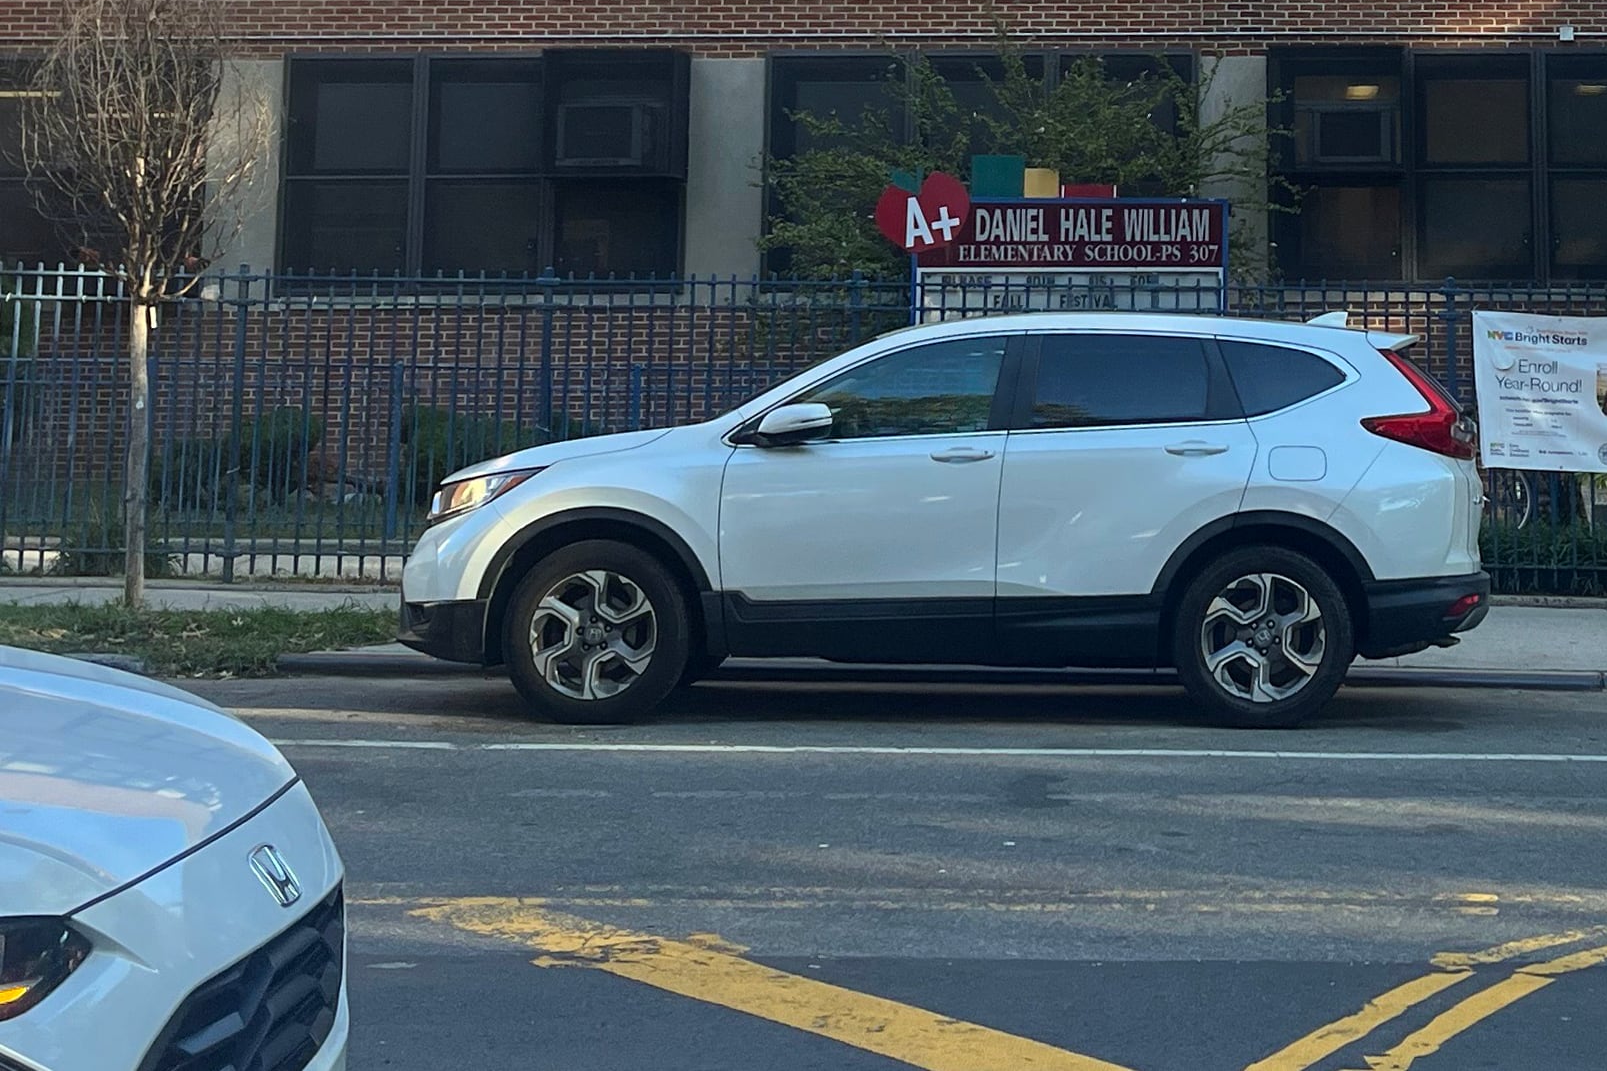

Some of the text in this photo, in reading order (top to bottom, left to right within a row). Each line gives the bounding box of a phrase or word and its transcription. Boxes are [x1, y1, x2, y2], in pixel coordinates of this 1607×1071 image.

[905, 196, 961, 248] A+
[975, 208, 1210, 242] DANIEL HALE WILLIAM
[958, 244, 1219, 263] ELEMENTARY SCHOOL-PS 307
[1487, 330, 1588, 346] NYC Bright Starts
[1518, 358, 1558, 374] Enroll
[1495, 374, 1583, 393] Year-Round!
